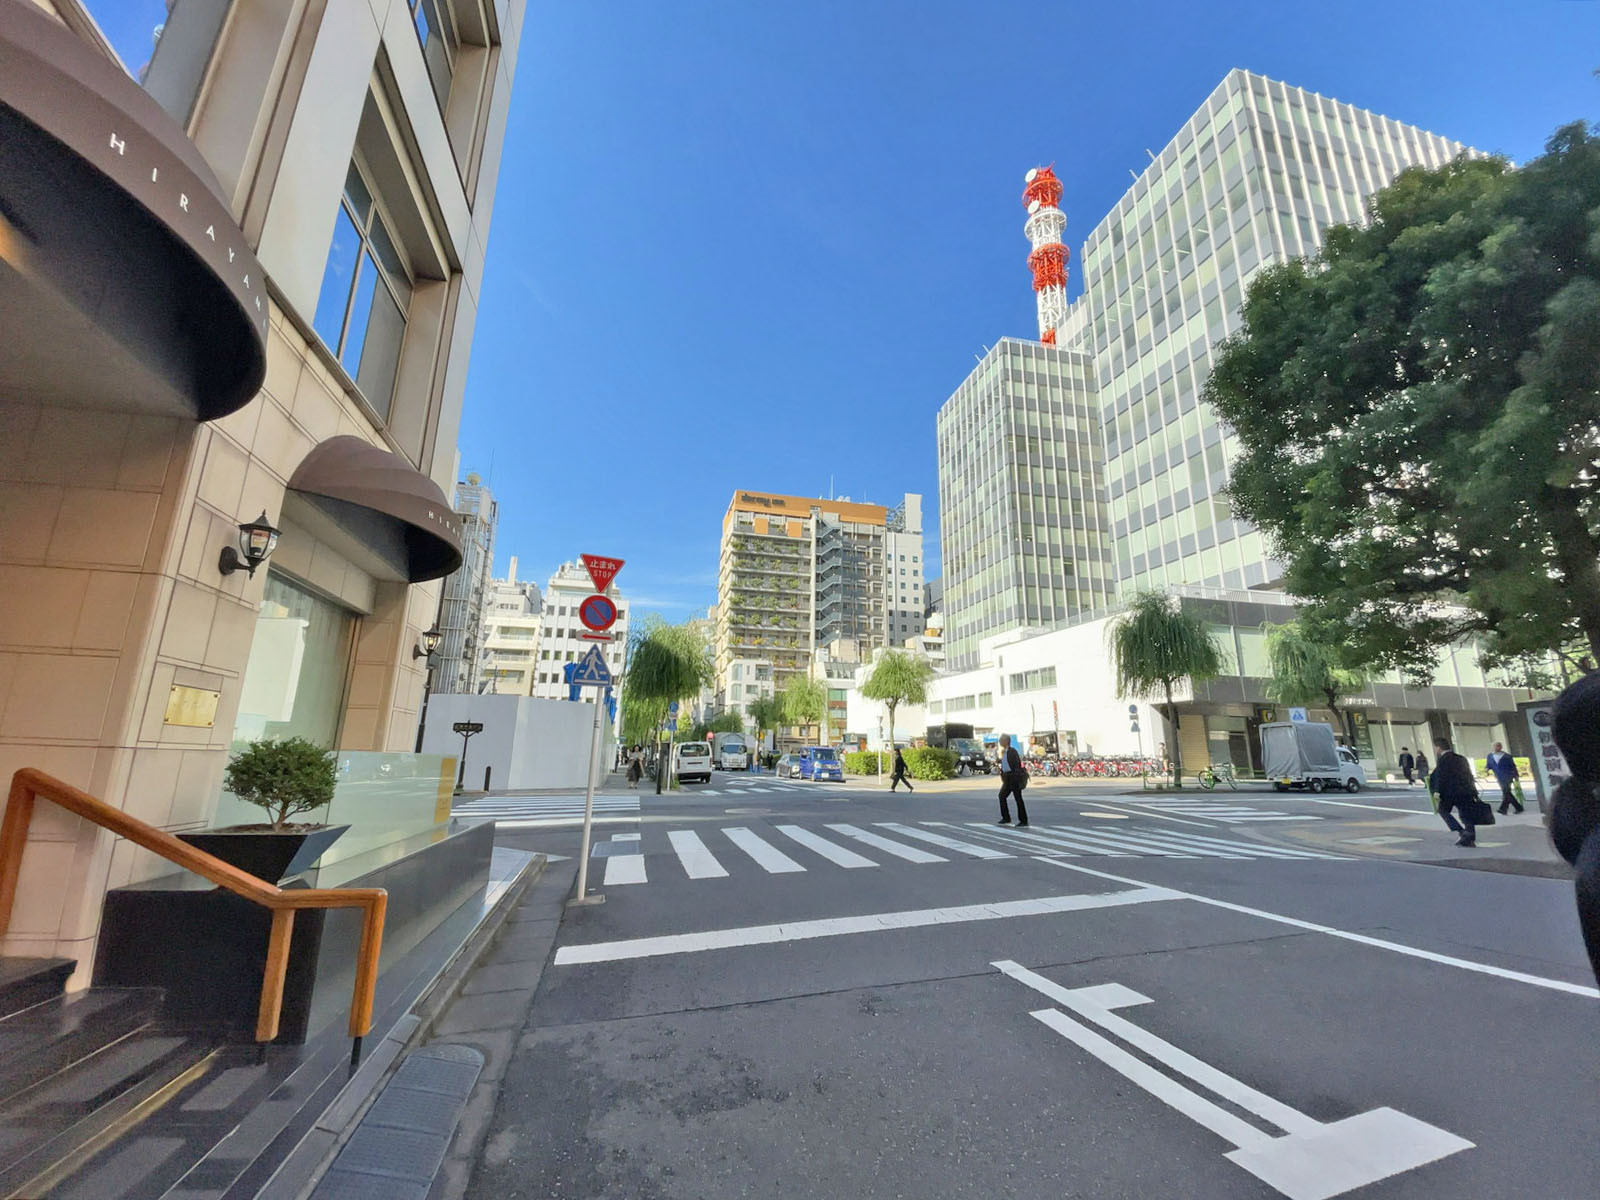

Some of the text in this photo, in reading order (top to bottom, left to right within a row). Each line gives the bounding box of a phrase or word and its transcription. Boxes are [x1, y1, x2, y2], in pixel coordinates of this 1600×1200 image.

[589, 559, 617, 571] 止まれ
[593, 570, 613, 578] STOP
